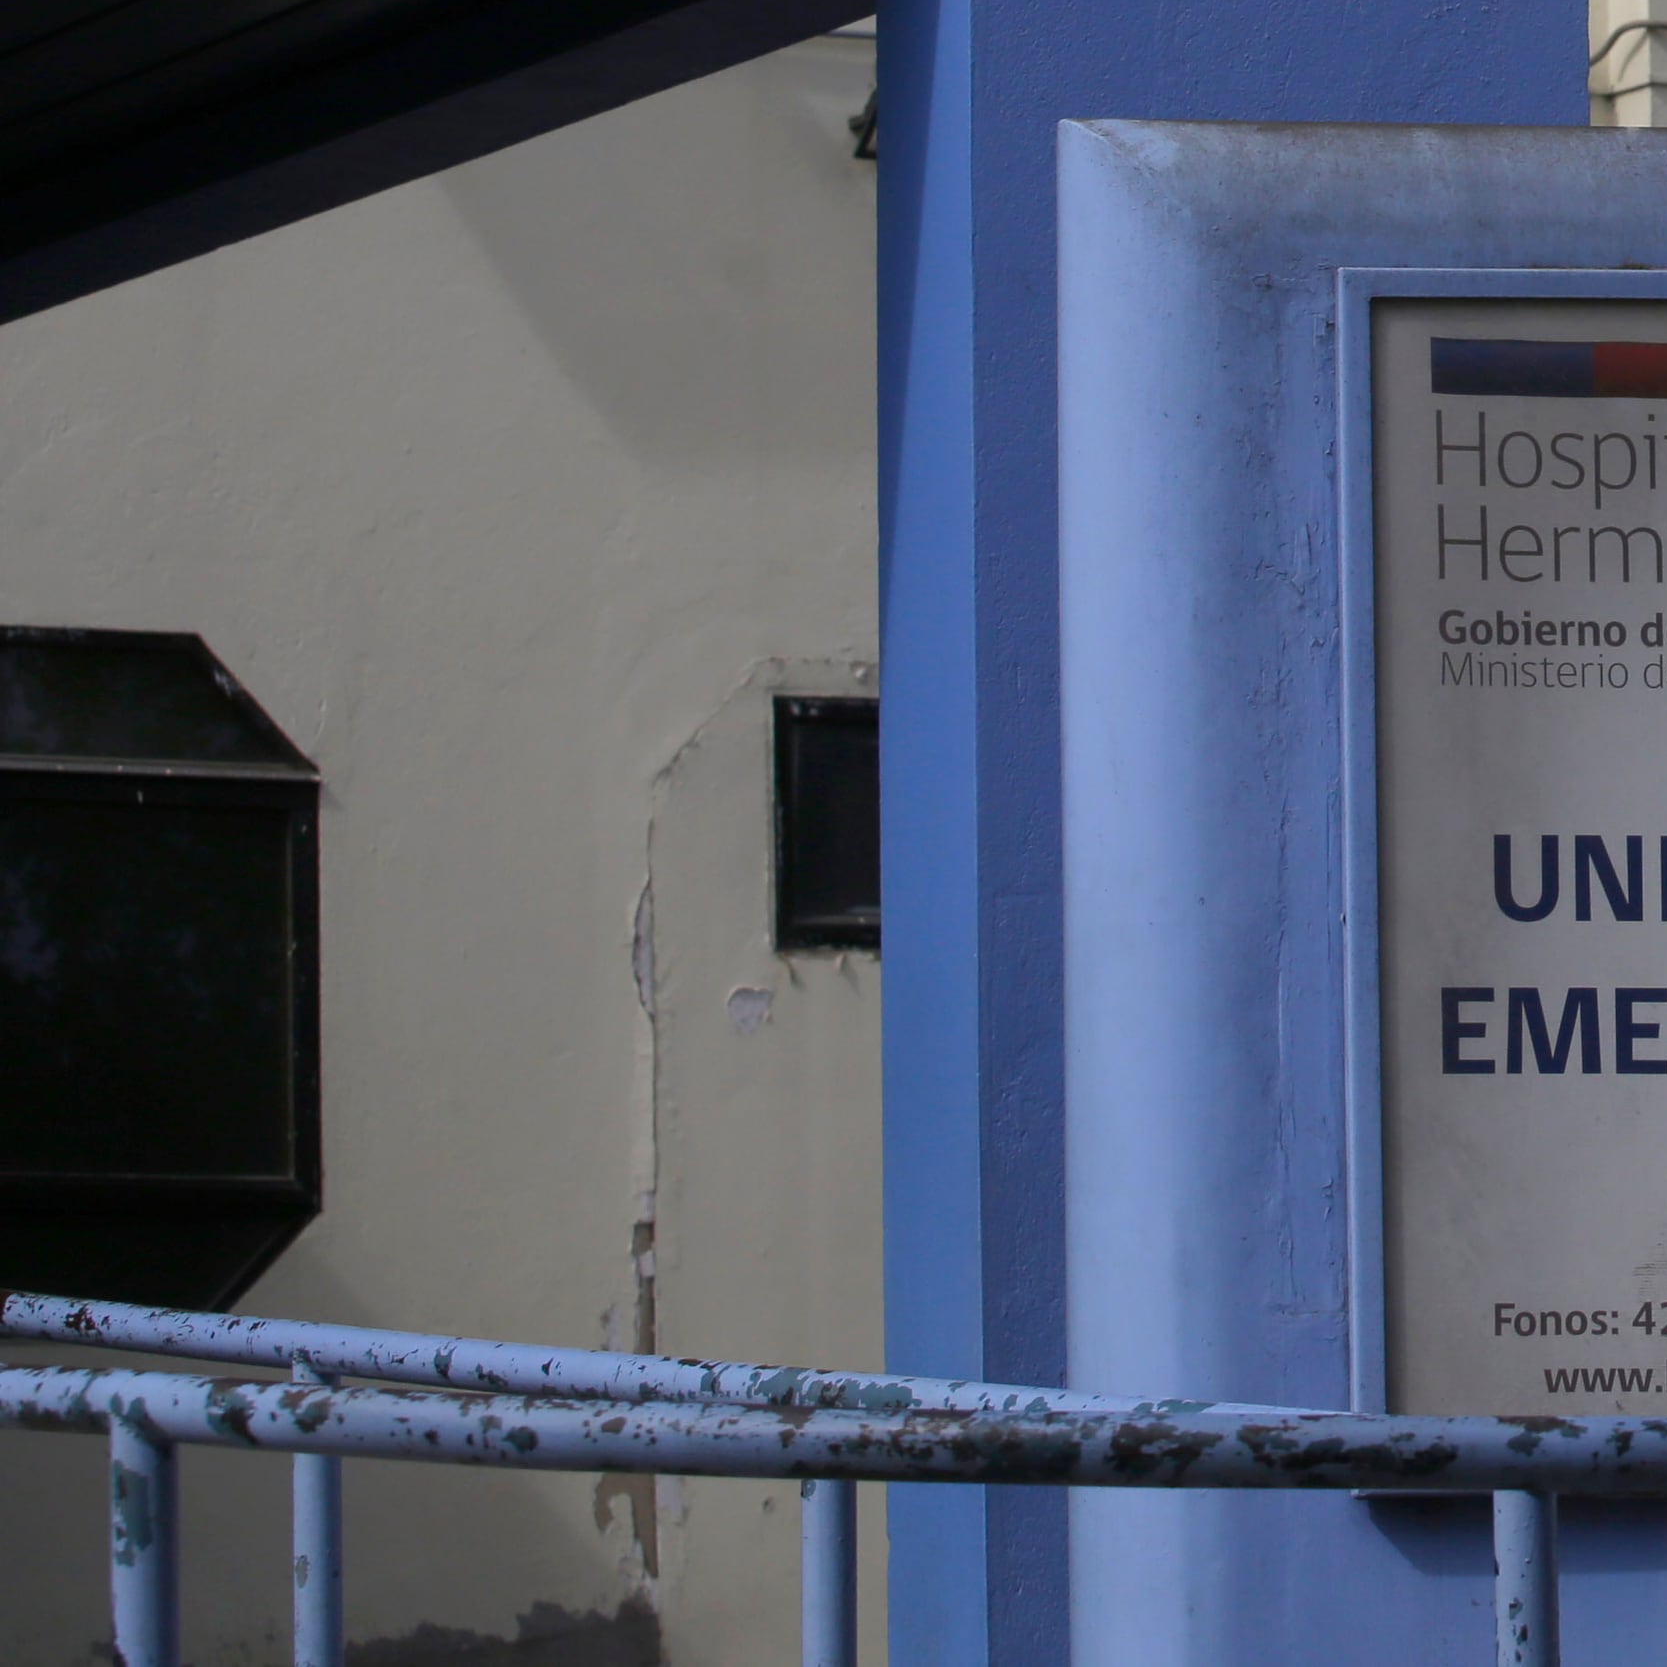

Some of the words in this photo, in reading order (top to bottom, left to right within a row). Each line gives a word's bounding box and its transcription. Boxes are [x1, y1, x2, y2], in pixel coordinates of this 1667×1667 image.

[1438, 609, 1627, 647] Gobierno
[1441, 651, 1629, 689] Ministerio
[1494, 1302, 1619, 1337] Fonos:
